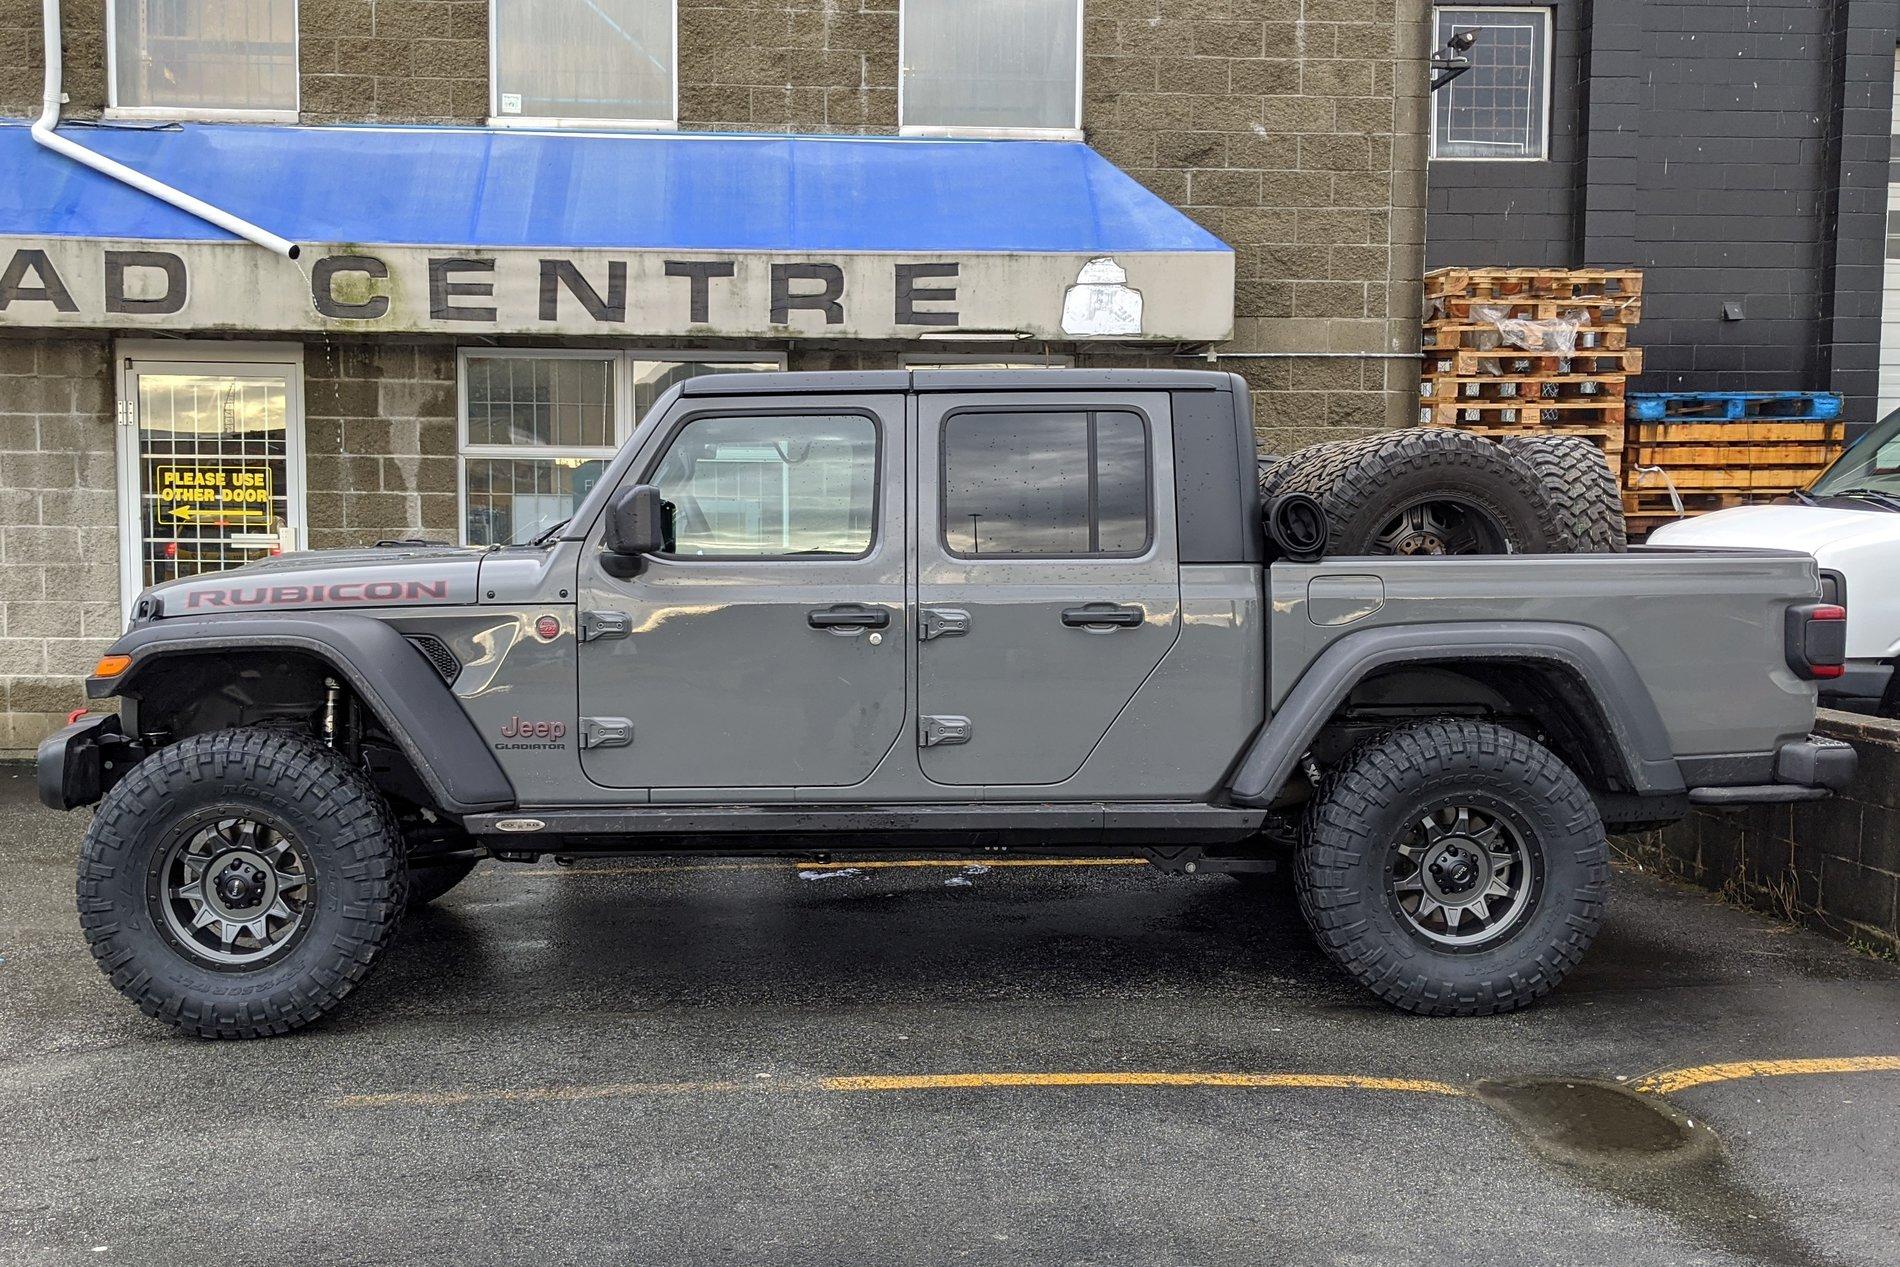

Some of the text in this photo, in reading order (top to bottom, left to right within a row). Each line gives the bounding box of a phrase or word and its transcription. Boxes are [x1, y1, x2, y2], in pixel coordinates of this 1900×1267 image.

[311, 256, 960, 325] CENTRE
[164, 472, 265, 487] PLEASE USE
[162, 488, 269, 502] OTHER DOOR
[186, 580, 449, 609] RUBICON
[501, 716, 566, 742] Jeep
[495, 743, 566, 751] GLADIATOR
